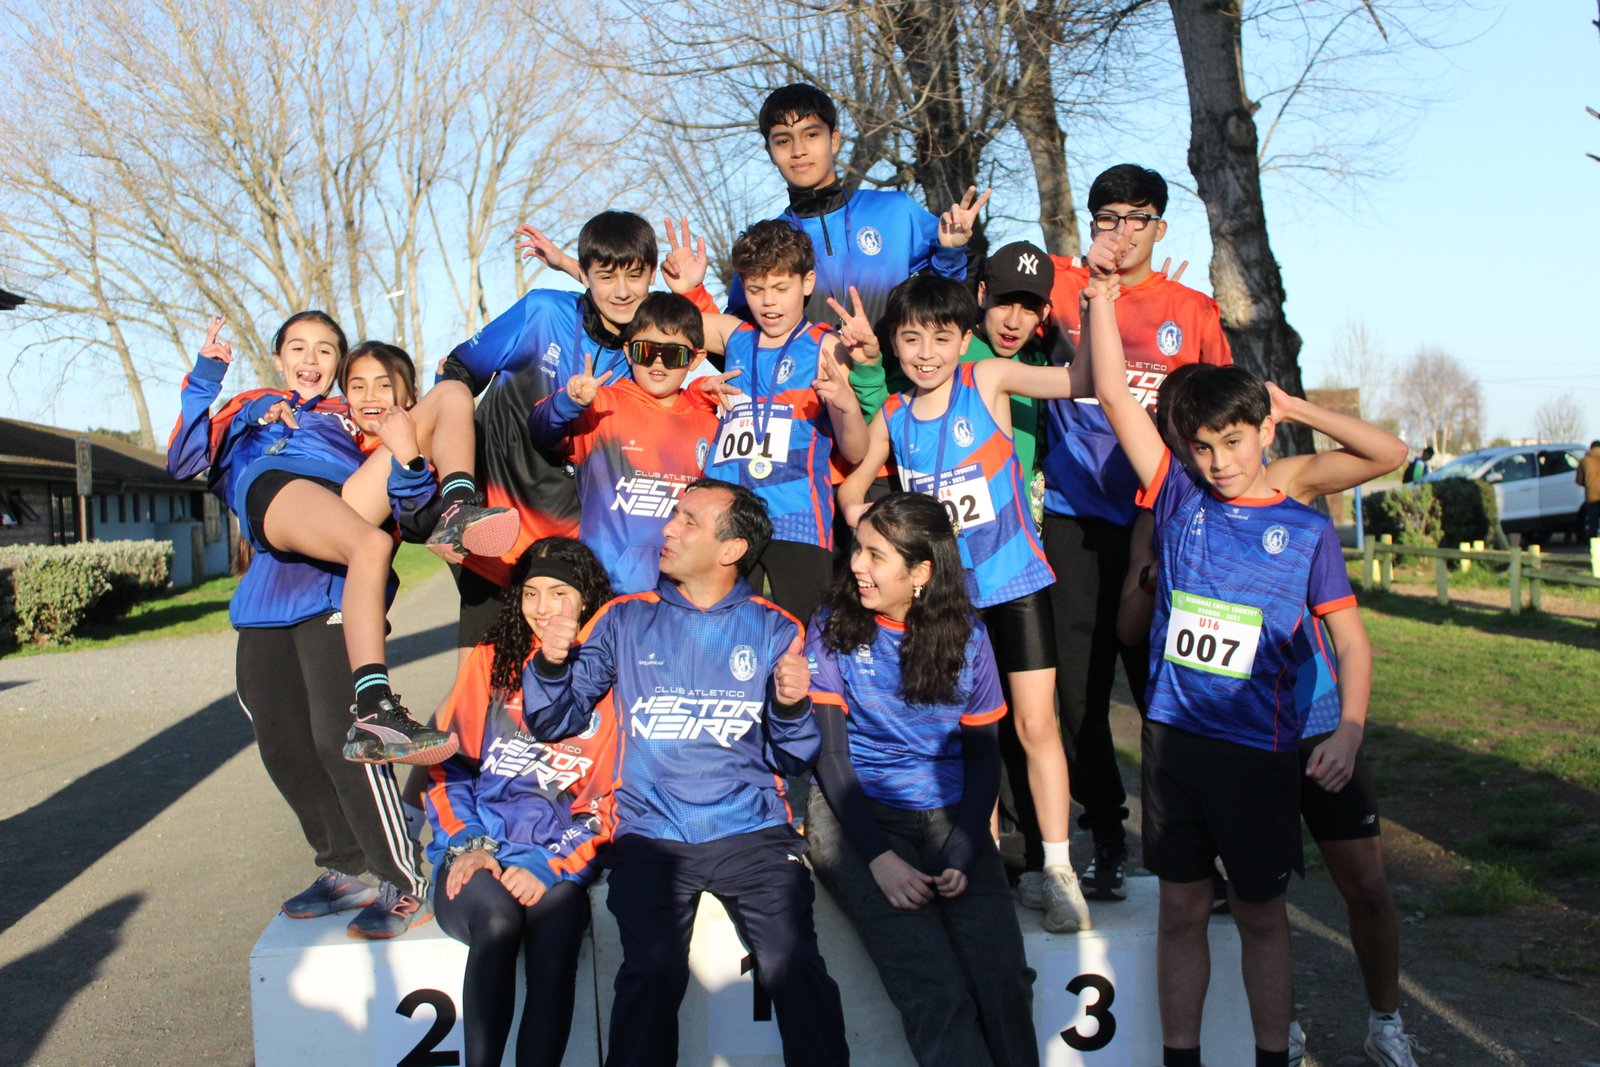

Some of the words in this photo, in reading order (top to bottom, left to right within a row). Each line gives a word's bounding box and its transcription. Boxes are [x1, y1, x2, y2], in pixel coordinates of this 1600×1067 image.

[1125, 360, 1167, 371] LETICO
[723, 431, 772, 459] 001
[615, 476, 690, 498] HECT
[635, 469, 661, 479] CLUB
[610, 492, 681, 518] NEI
[1199, 617, 1220, 631] U16
[1231, 606, 1259, 616] COUNTRY
[1176, 628, 1241, 667] 007
[654, 686, 685, 695] CLUB
[687, 689, 745, 698] ATLETICO
[630, 695, 764, 724] HECTOR
[630, 714, 754, 748] NEIRA
[1060, 973, 1117, 1052] 3
[395, 988, 460, 1067] 2
